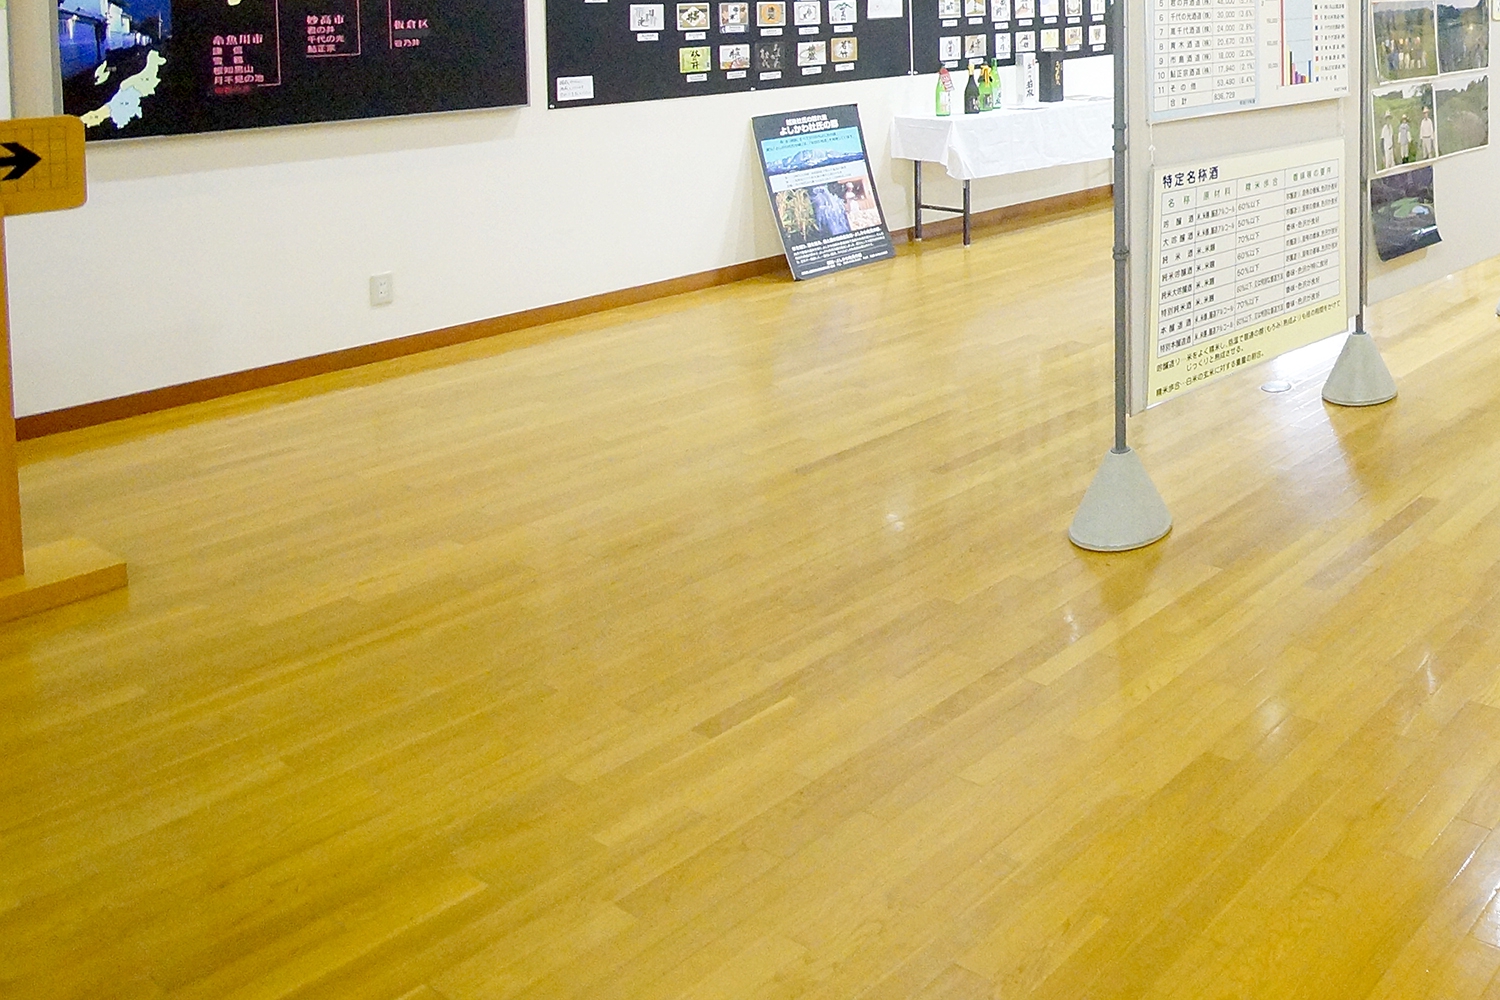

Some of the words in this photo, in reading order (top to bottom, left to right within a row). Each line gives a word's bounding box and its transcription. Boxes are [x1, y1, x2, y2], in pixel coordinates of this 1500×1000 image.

[306, 15, 345, 25] 妙高市
[212, 34, 263, 45] 糸魚川市
[1163, 165, 1219, 189] 特定名称酒
